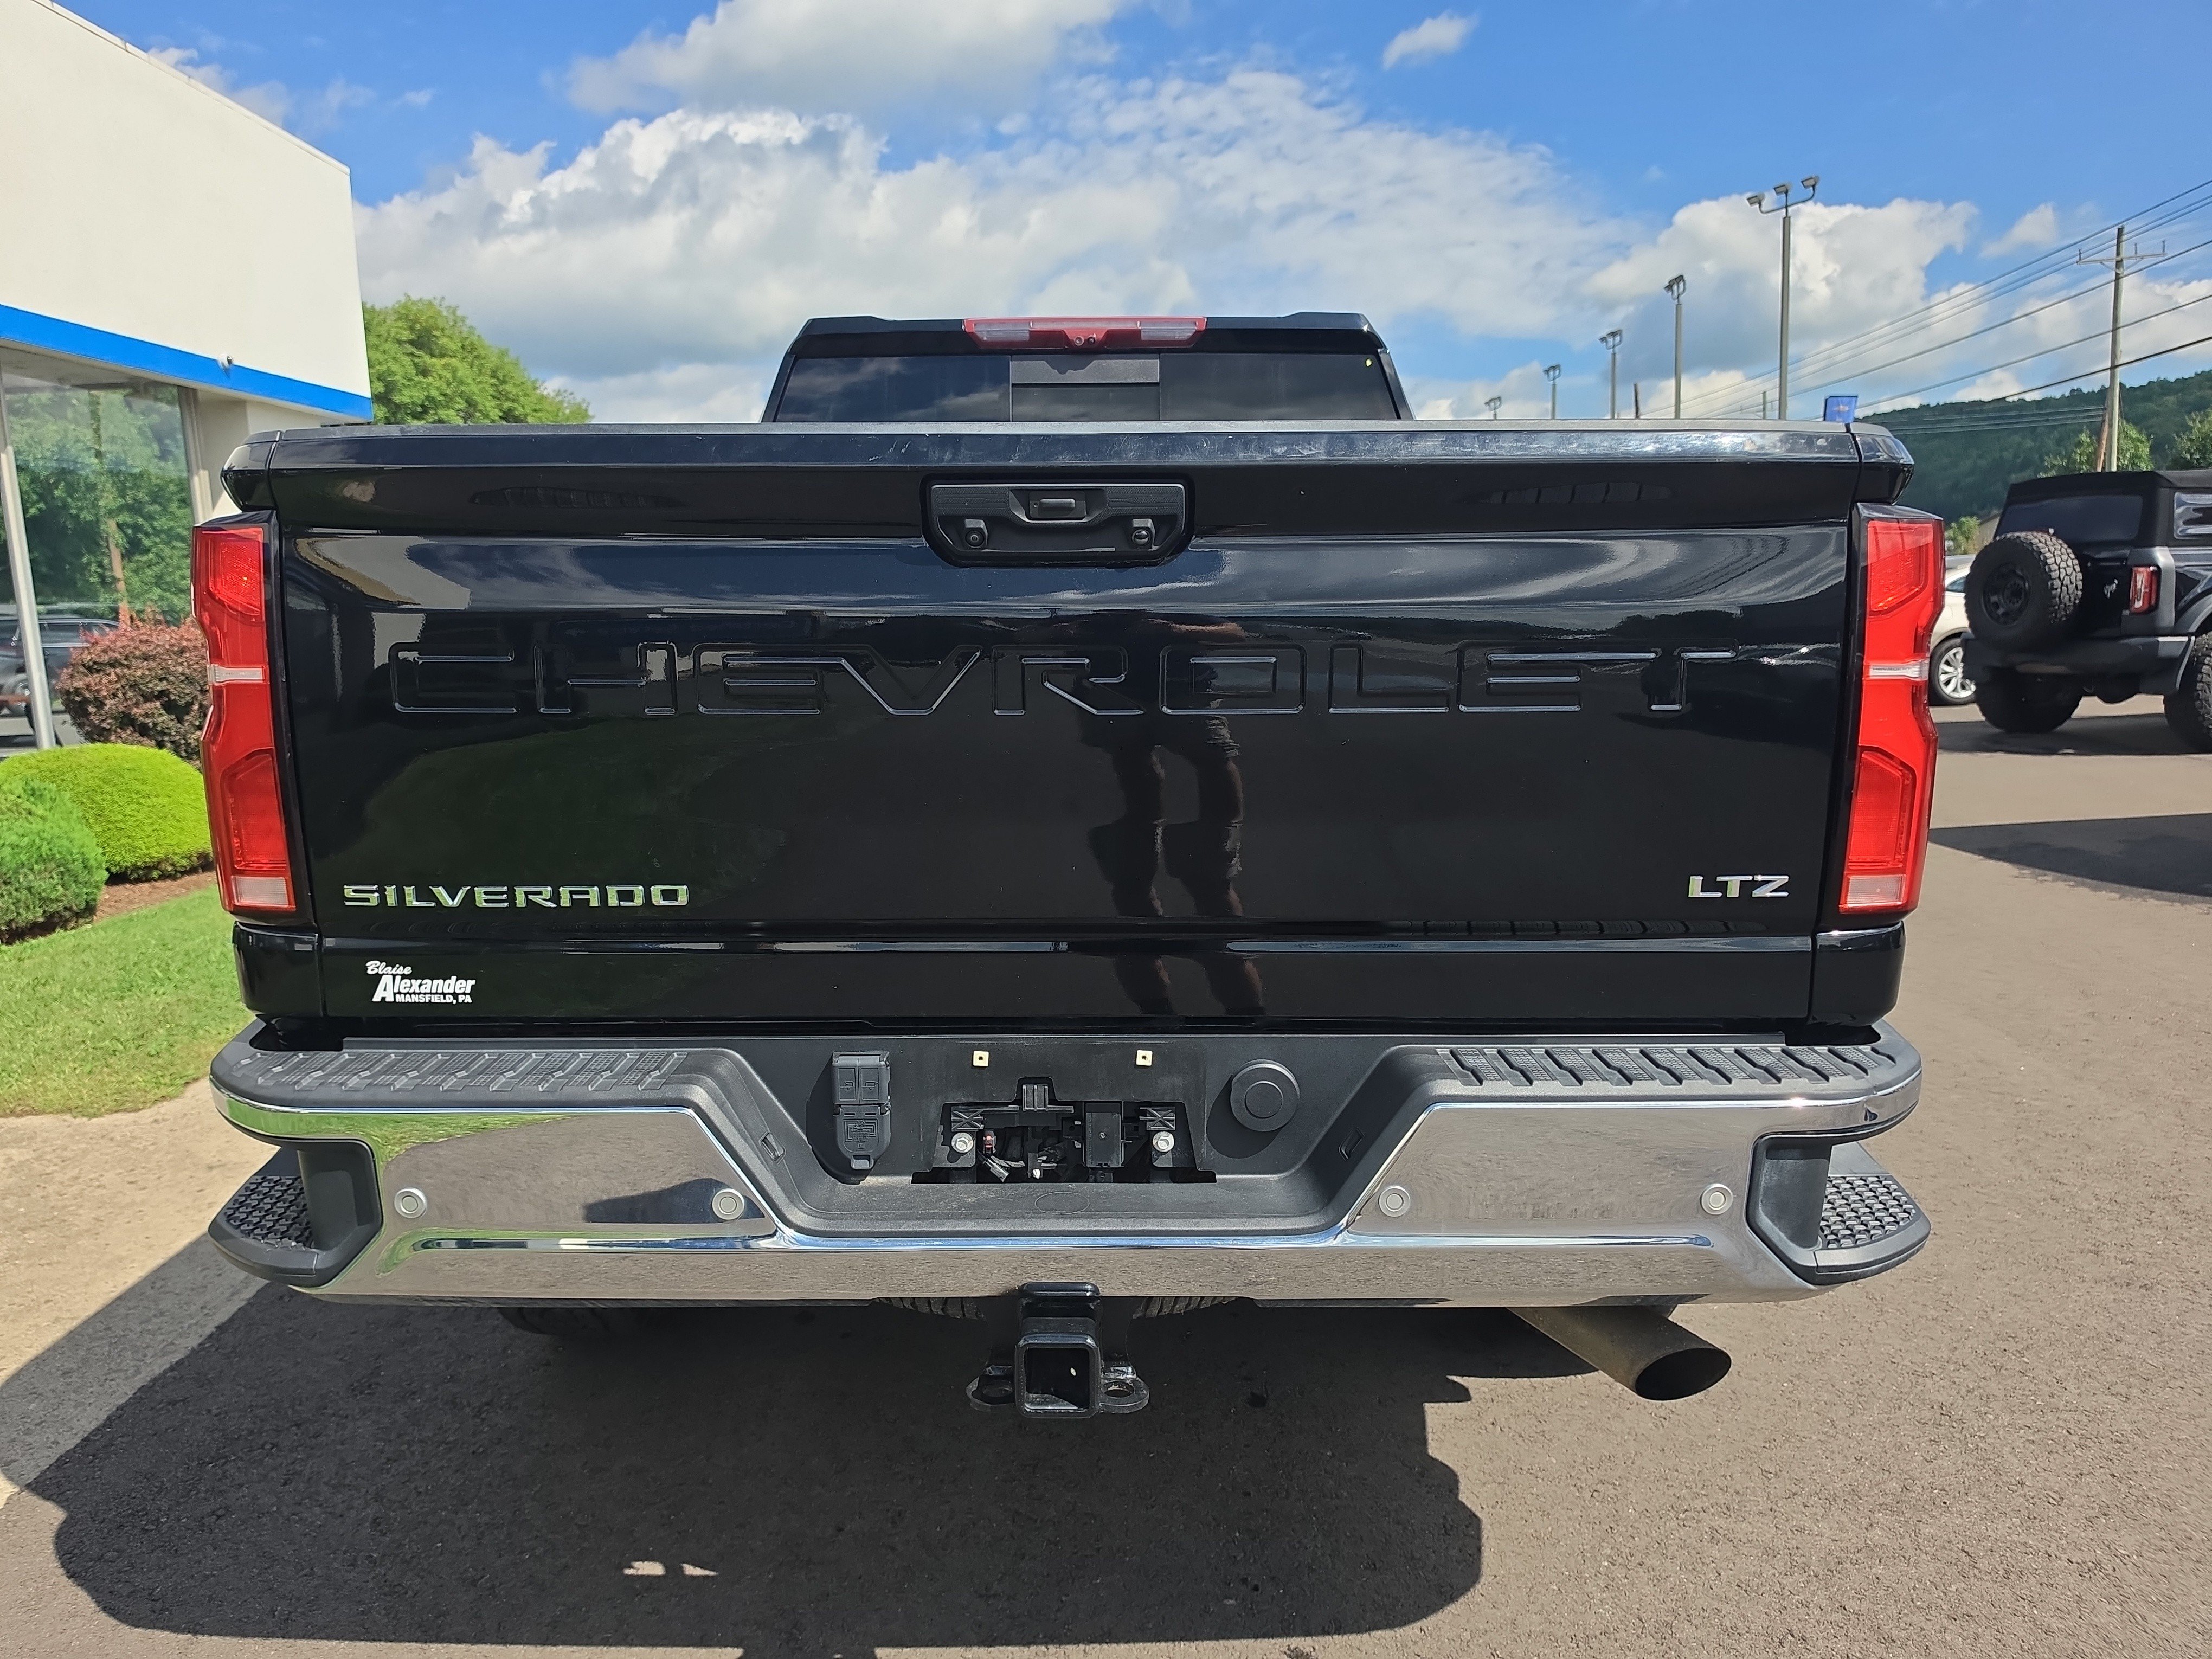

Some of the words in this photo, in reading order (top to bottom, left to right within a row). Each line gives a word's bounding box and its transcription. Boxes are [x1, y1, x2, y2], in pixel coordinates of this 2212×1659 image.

[387, 642, 1738, 716] CHEVROLET
[343, 884, 690, 908] SILVERADO
[1688, 875, 1789, 898] LTZ
[365, 960, 413, 975] Blaise
[371, 974, 476, 1002] Alexander
[395, 994, 456, 1005] MANSFIELD,
[458, 994, 472, 1003] PA
